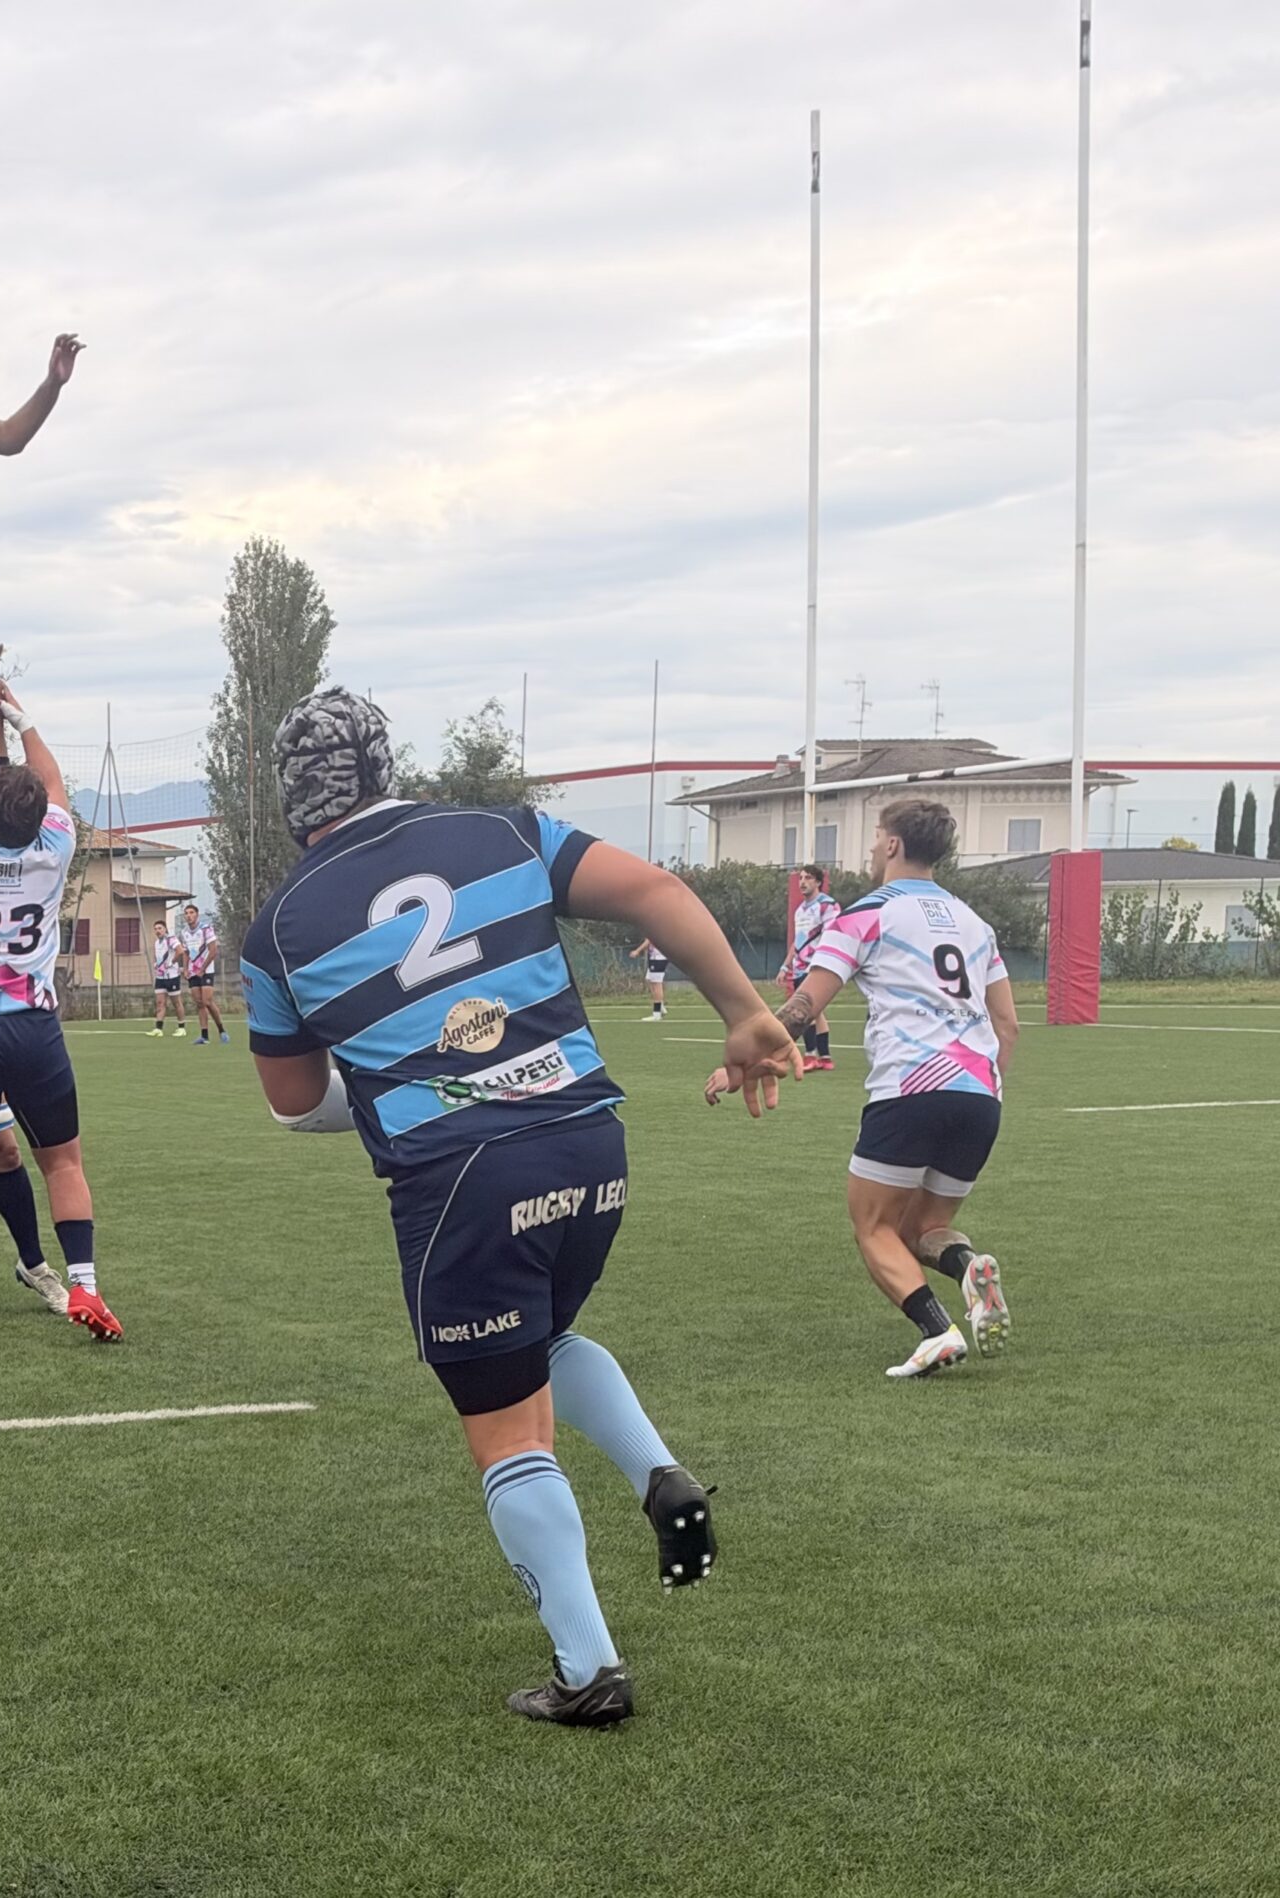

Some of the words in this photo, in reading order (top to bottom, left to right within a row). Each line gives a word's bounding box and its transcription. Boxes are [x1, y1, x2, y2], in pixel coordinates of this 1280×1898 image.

[368, 873, 483, 992] 2
[933, 944, 972, 1000] 9
[439, 998, 507, 1051] Agostani
[466, 1024, 496, 1045] CAFFÈ
[511, 1186, 587, 1236] RUGBY
[472, 1309, 522, 1339] LAKE
